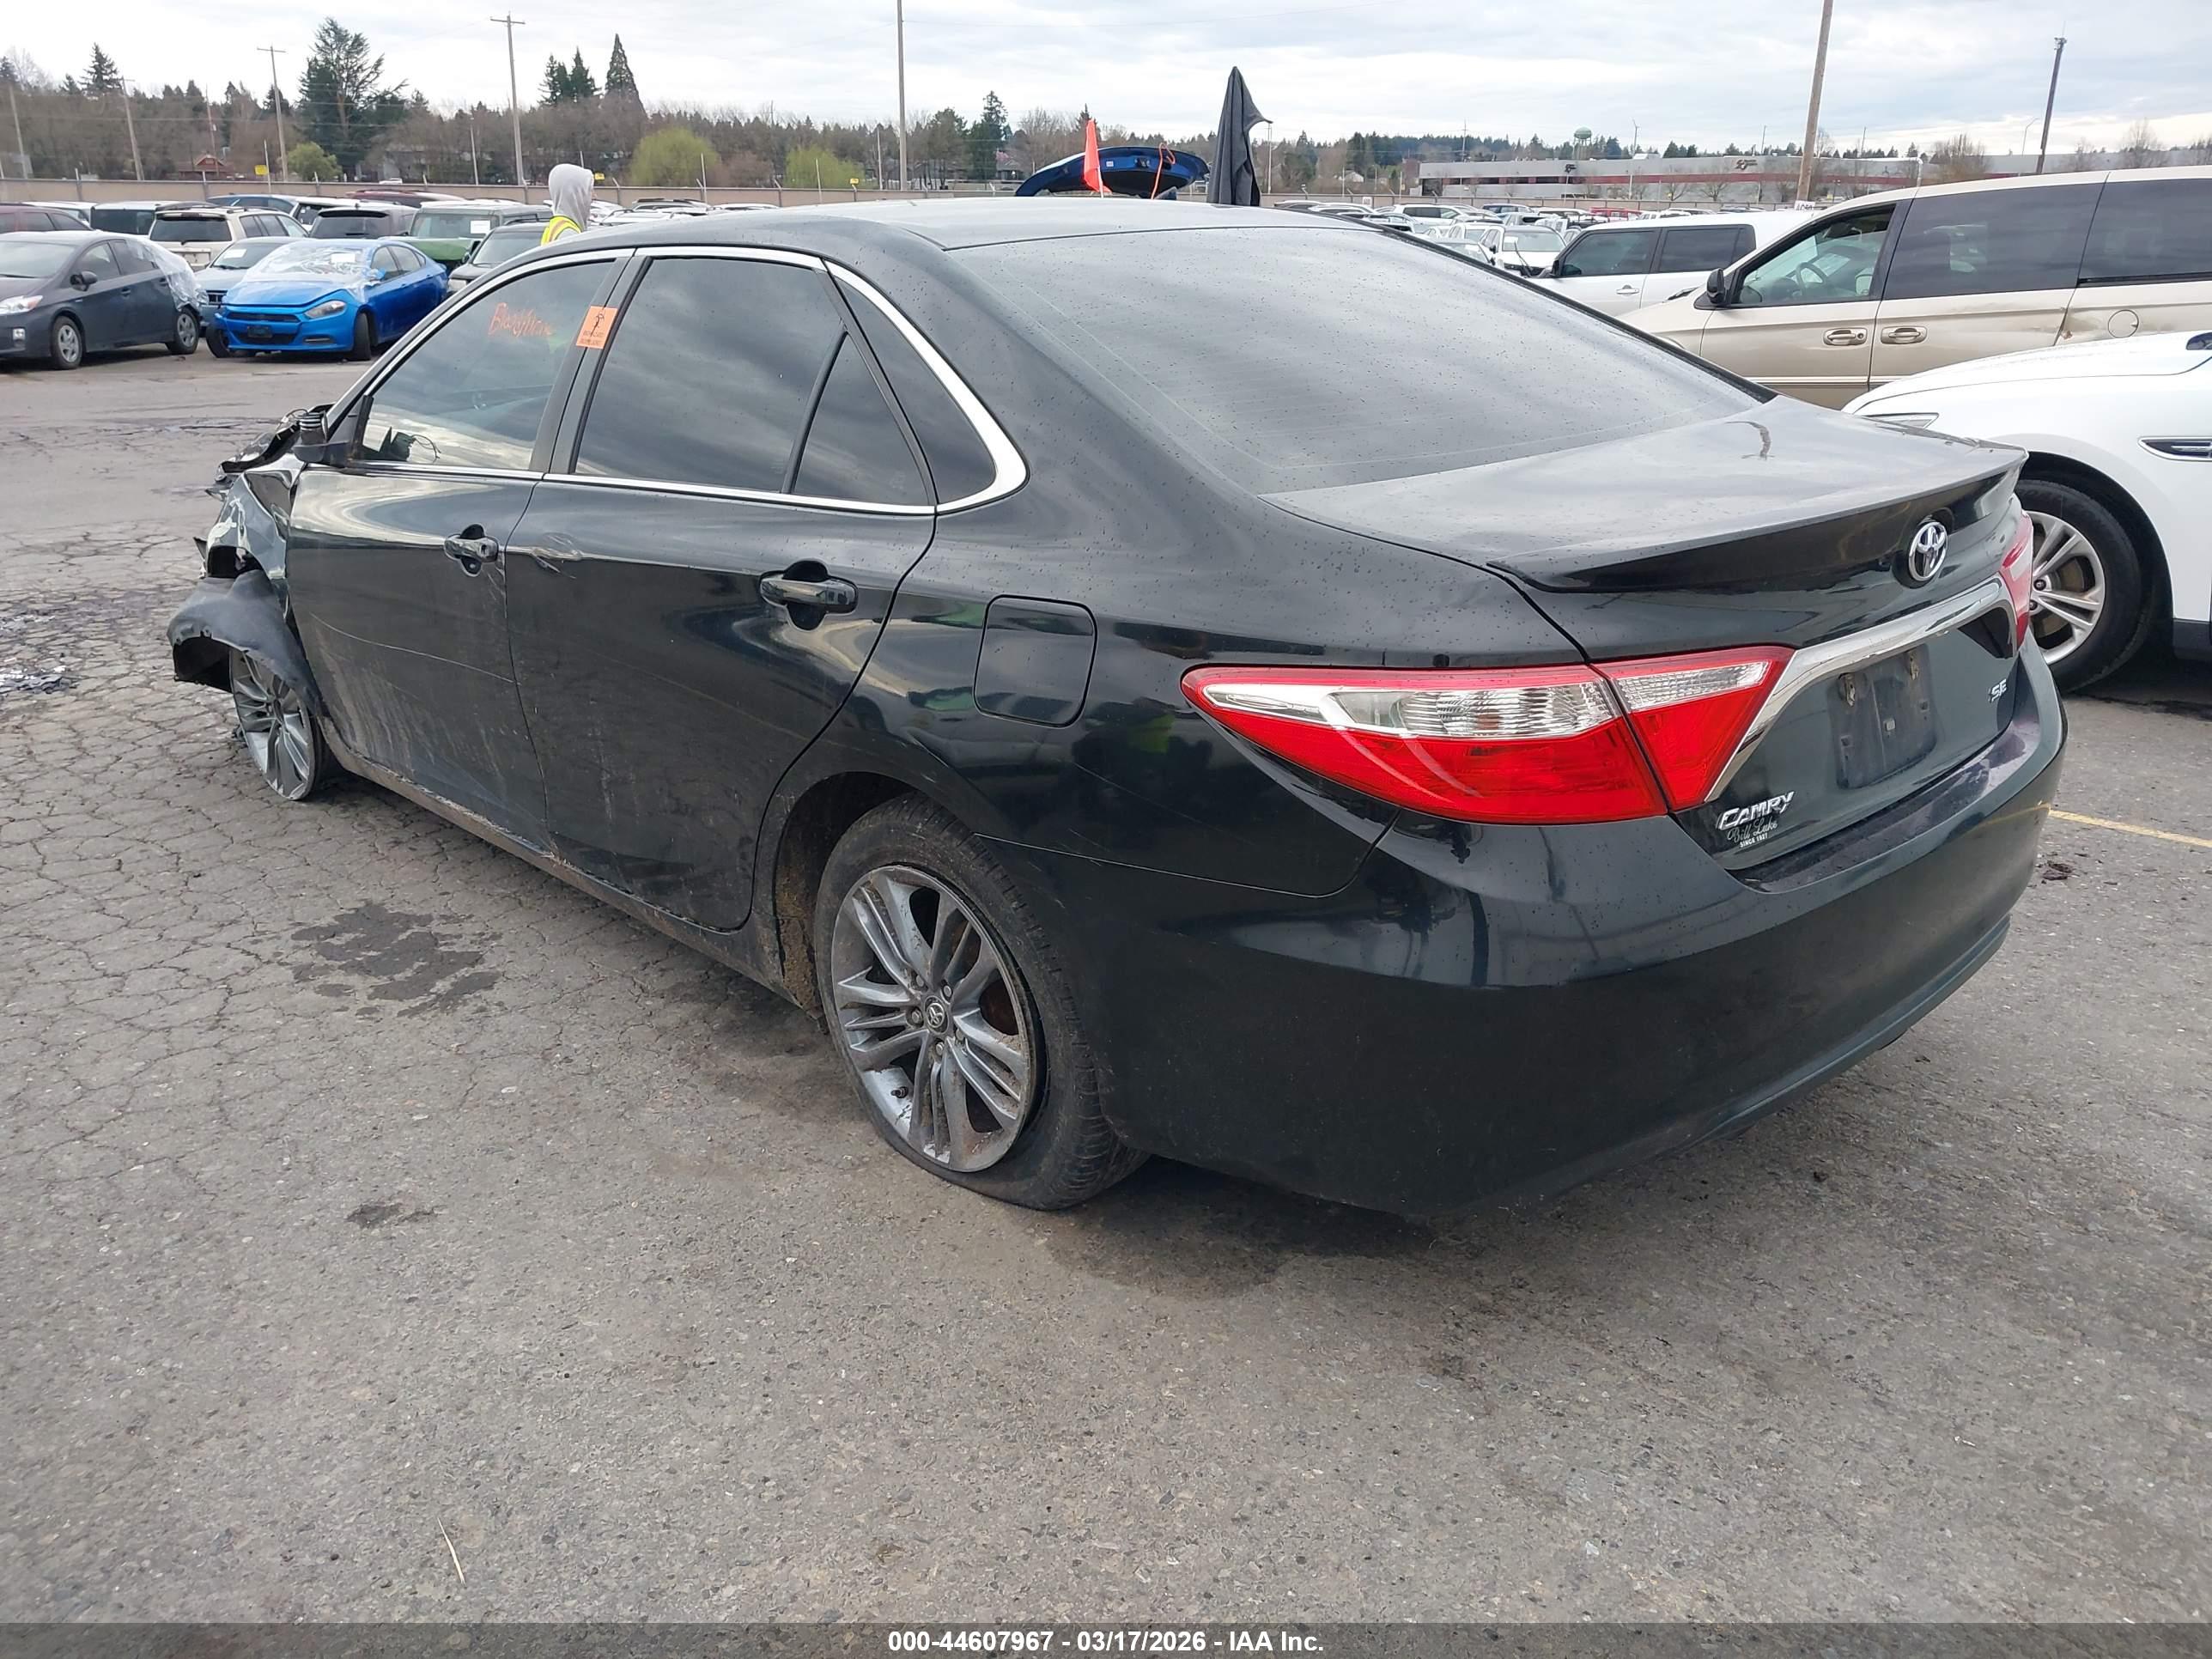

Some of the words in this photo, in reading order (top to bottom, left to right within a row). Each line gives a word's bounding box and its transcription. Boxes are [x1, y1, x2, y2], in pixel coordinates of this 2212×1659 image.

[1990, 678, 2007, 702] SE
[1717, 791, 1795, 830] CAMRY
[1727, 823, 1752, 843] Bill
[1753, 816, 1778, 836] Luke
[1740, 836, 1756, 848] SINCE
